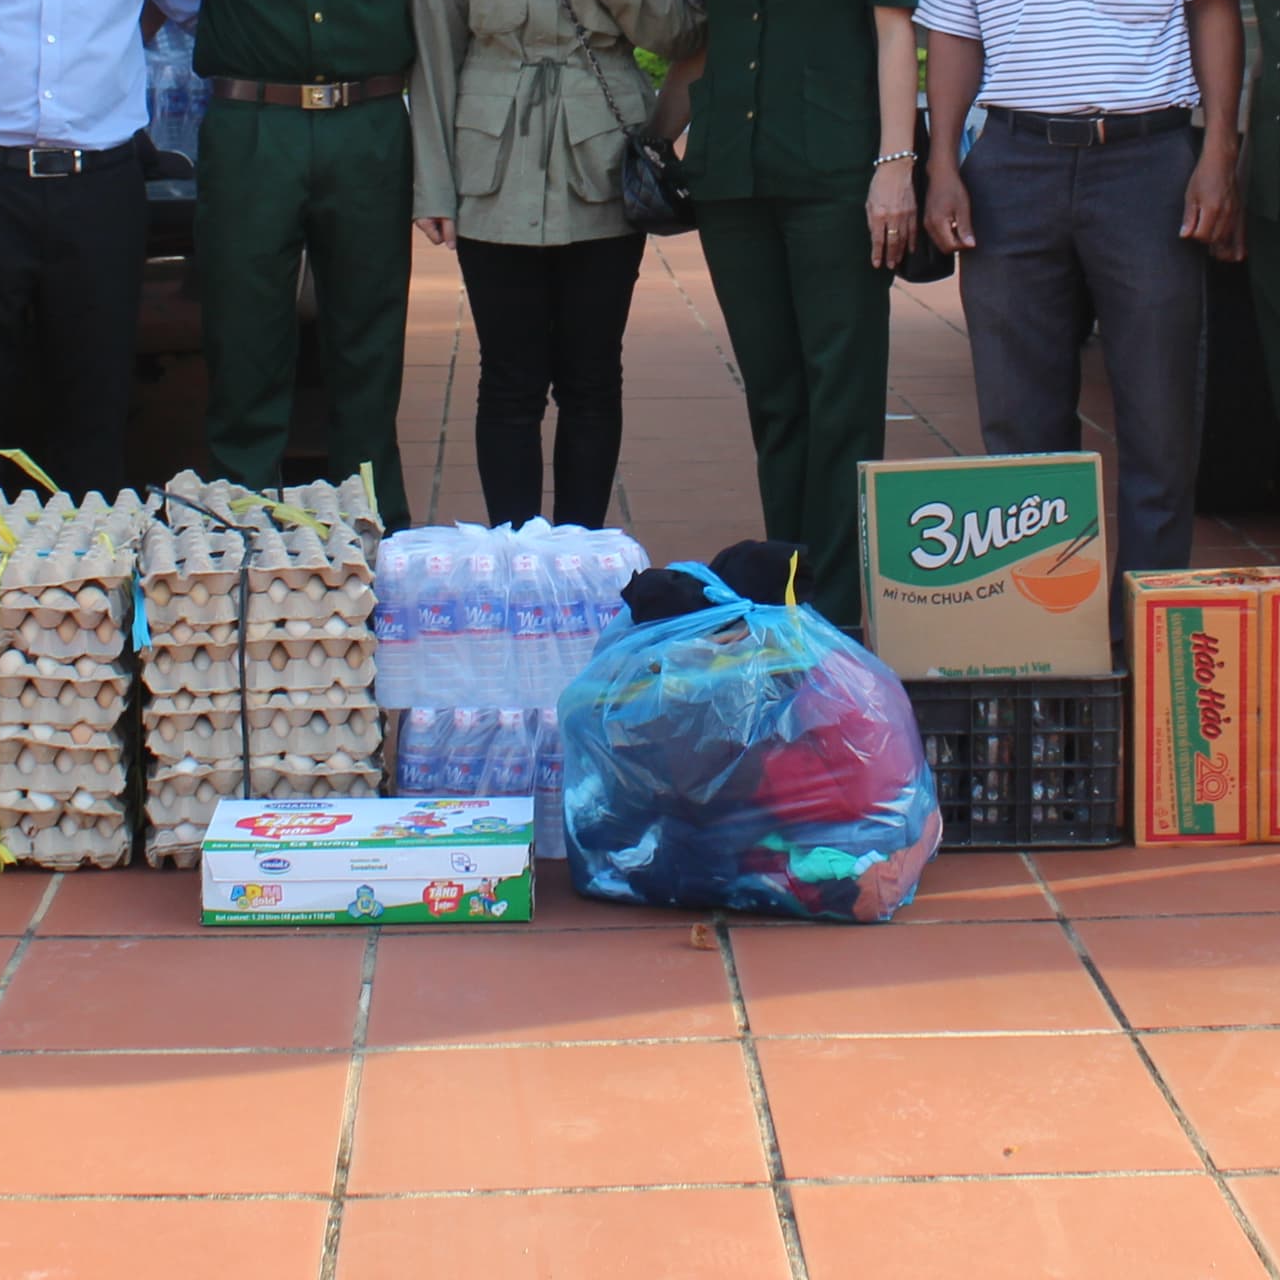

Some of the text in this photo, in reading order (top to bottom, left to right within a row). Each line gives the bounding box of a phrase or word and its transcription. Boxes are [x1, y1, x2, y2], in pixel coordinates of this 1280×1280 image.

[882, 580, 1006, 606] MÌ TÔM CHUA CAY
[1188, 631, 1230, 741] Hảo Hảo
